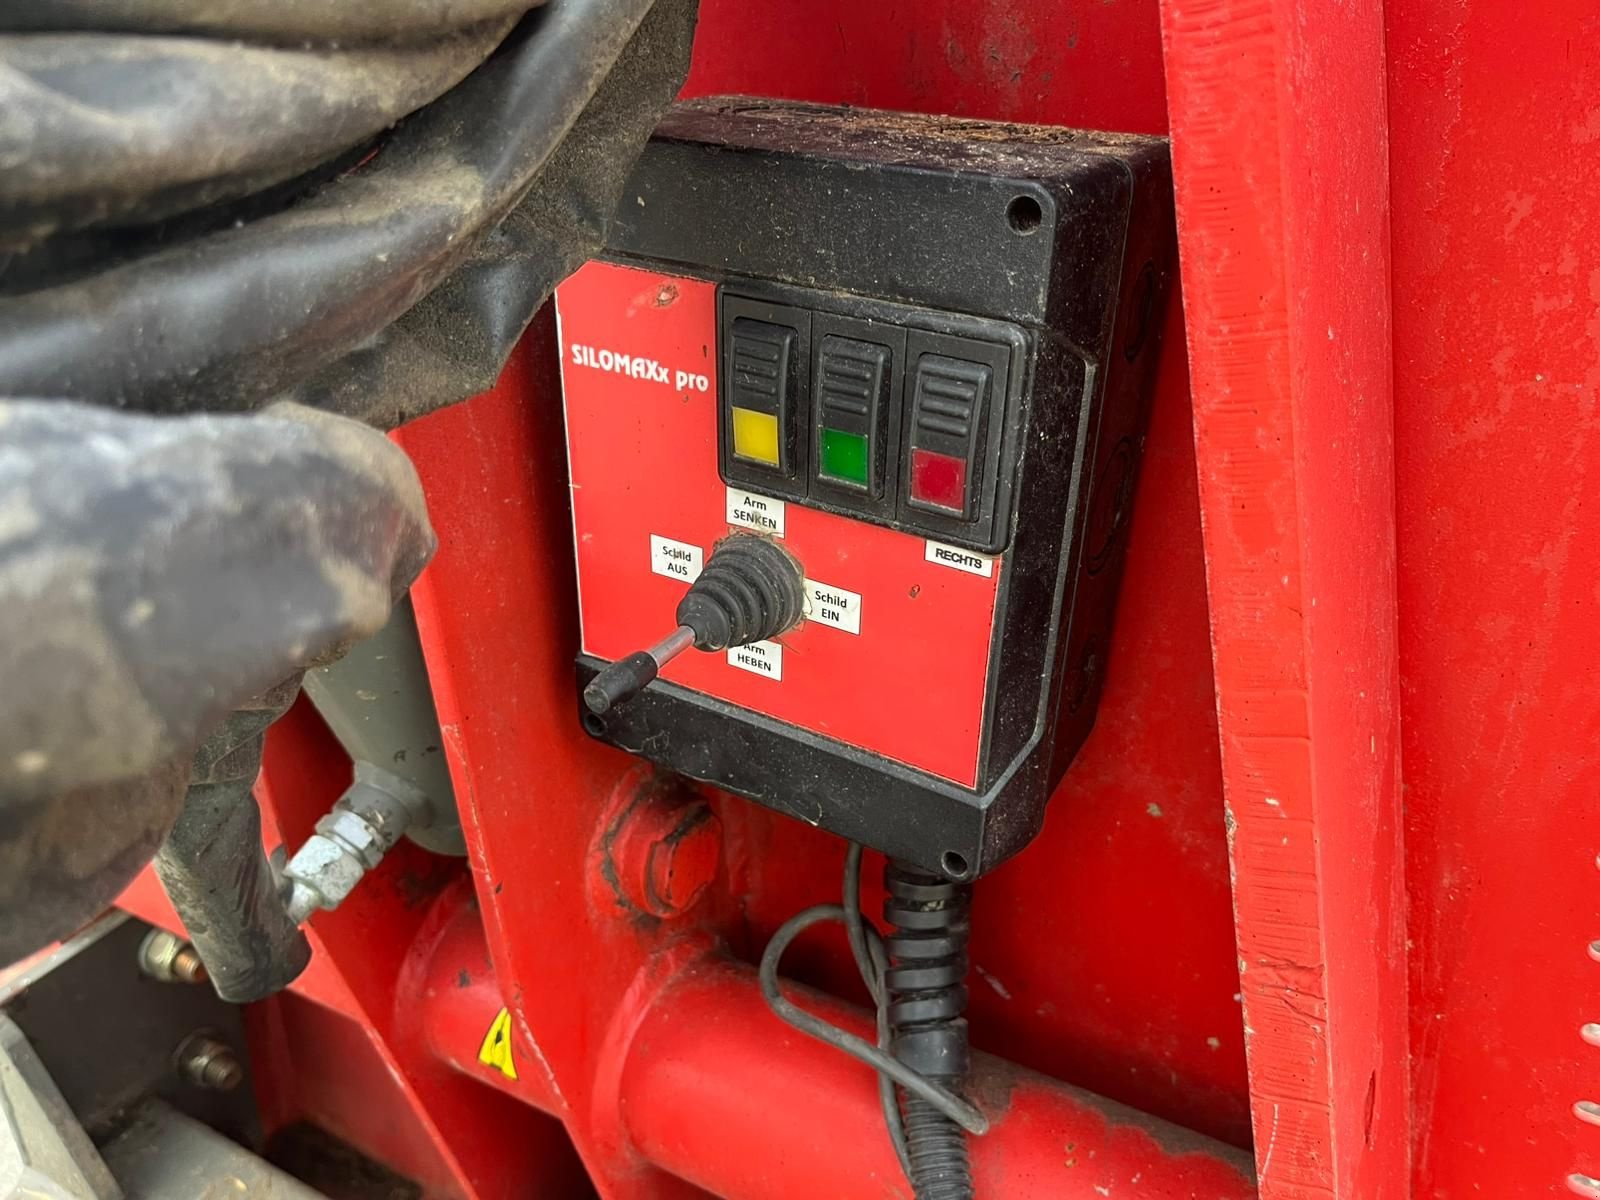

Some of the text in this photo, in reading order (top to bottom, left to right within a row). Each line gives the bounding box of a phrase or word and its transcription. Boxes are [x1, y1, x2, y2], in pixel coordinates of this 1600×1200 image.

[571, 343, 709, 392] SILOMAXx pro
[743, 496, 767, 511] Arm
[733, 509, 777, 529] SENKEN
[935, 547, 983, 569] RECHTS
[667, 562, 688, 576] AUS
[815, 590, 847, 609] Schild
[821, 608, 840, 622] EIN
[737, 653, 772, 672] HEBEN
